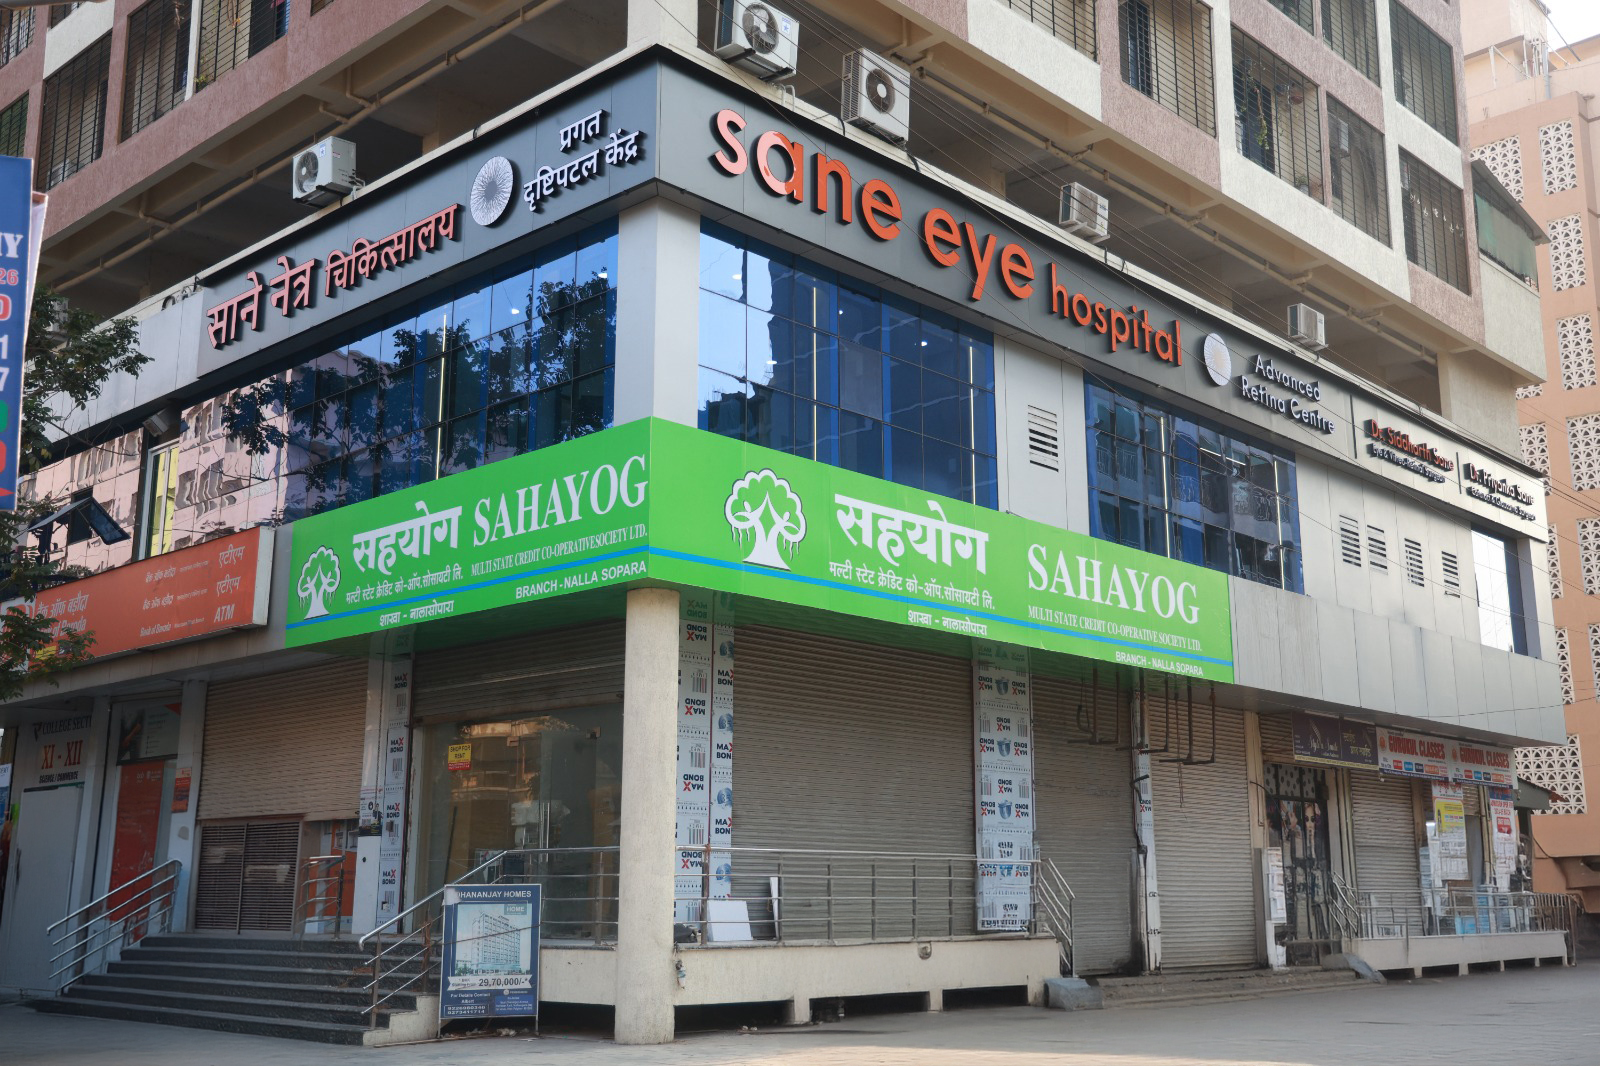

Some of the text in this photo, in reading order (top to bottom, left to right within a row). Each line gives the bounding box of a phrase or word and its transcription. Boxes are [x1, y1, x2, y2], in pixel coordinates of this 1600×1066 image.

[560, 109, 602, 151] प्रगत
[523, 127, 640, 212] दृष्टिपटल केंद्र
[714, 109, 1182, 366] sane eye hospital
[206, 203, 462, 349] साने नेत्र चिकित्सालय
[1256, 354, 1320, 401] Advanced
[1241, 375, 1335, 434] Retina Centre
[473, 454, 648, 547] SAHAYOG
[353, 500, 463, 576] सहयोग
[835, 494, 989, 575] सहयोग
[219, 544, 246, 569] एटीएम
[471, 559, 493, 577] MULTI
[493, 555, 514, 573] STATE
[515, 548, 541, 567] CREDIT
[629, 523, 648, 541] LTD.
[216, 574, 242, 598] एटीएम
[516, 580, 558, 600] BRANCH
[564, 570, 599, 592] NALLA
[601, 560, 647, 583] SOPARA
[829, 559, 853, 581] मल्टी
[856, 563, 875, 585] स्टेट
[982, 590, 995, 610] लि.
[1028, 544, 1199, 624] SAHAYOG
[214, 604, 235, 624] ATM
[379, 611, 401, 627] शाखा
[410, 599, 455, 621] नालासोपारा
[908, 610, 932, 626] शाखा
[942, 616, 988, 637] नालासोपारा
[686, 623, 707, 633] BOND
[686, 631, 707, 642] MAX
[1028, 605, 1202, 652] MULTI STATE CREDIT CO-OPERATIVE SOCIETY LTD.
[1115, 651, 1147, 666] BRANCH
[1152, 657, 1175, 672] NALLA
[1176, 661, 1204, 677] SOPARA
[684, 697, 706, 706] BOND
[684, 705, 706, 716] MAX
[42, 718, 71, 735] COLLEGE
[41, 743, 56, 769] XI
[64, 740, 83, 767] XII
[1418, 739, 1446, 760] CLASSES
[682, 773, 705, 782] BOND
[682, 781, 704, 791] MAX
[387, 803, 400, 812] MAX
[382, 869, 396, 879] MAX
[503, 890, 532, 898] HOMES
